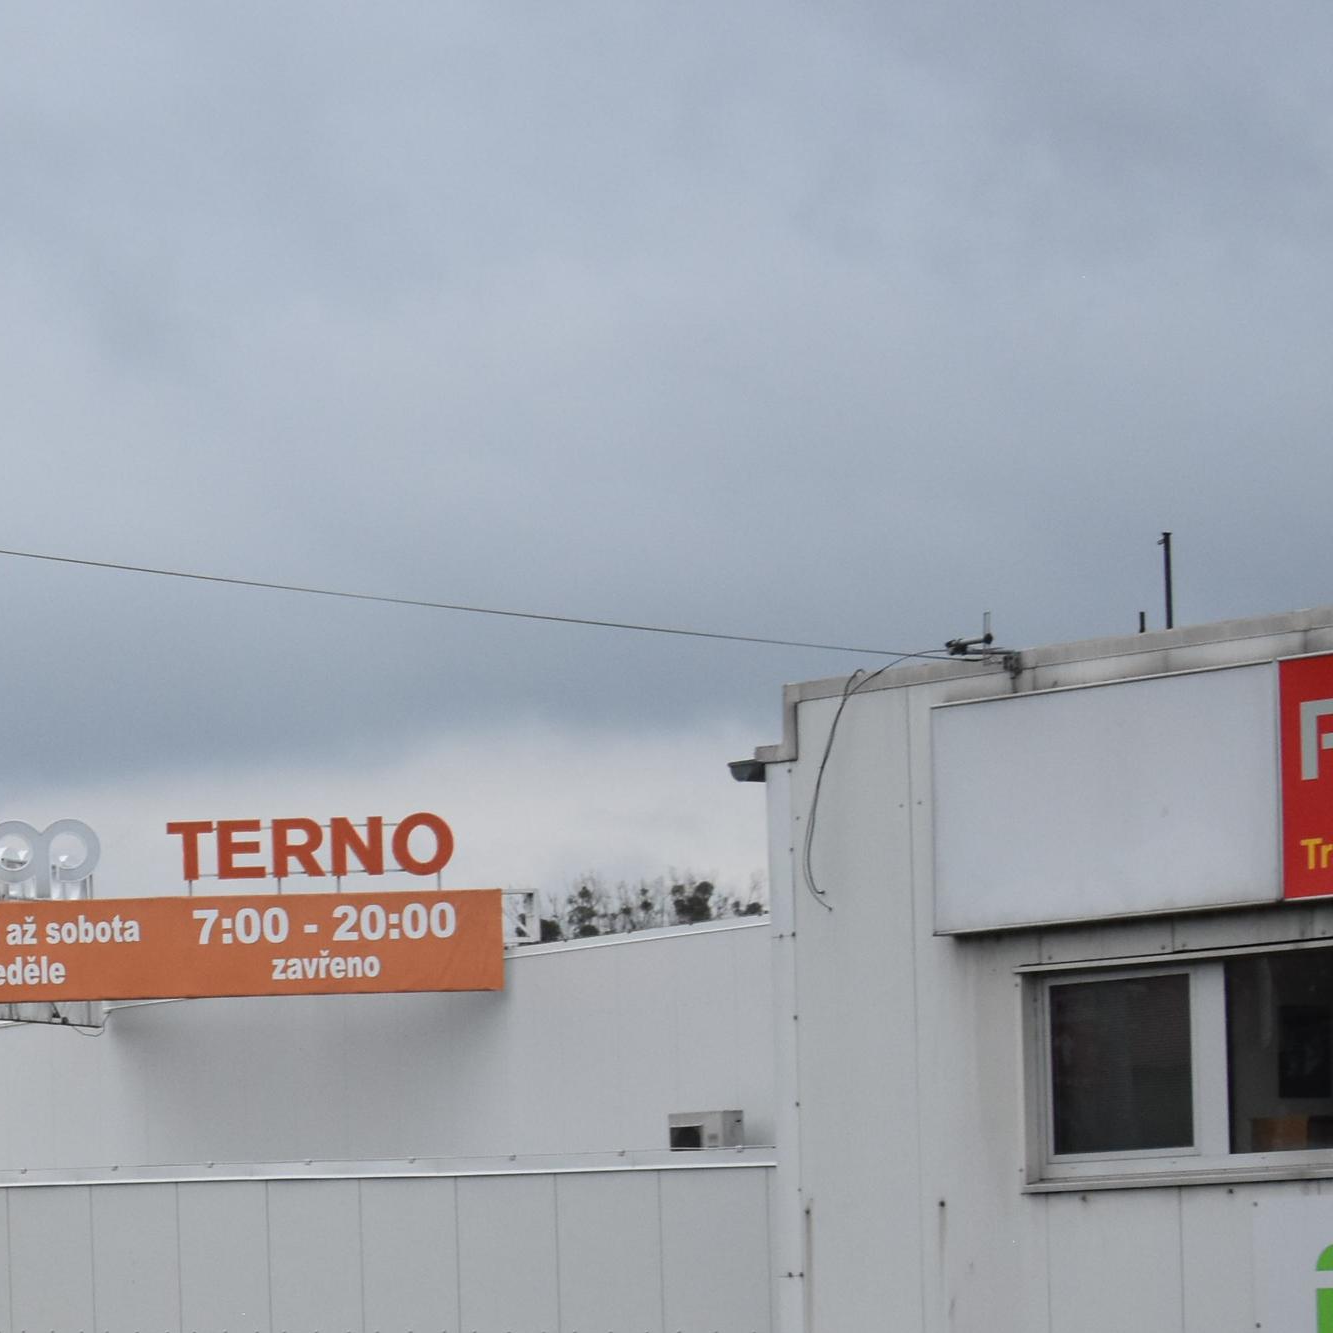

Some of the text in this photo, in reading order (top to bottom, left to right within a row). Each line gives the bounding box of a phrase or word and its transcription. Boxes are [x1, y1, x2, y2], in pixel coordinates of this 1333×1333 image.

[166, 812, 454, 881] TERNO
[6, 916, 38, 946] až
[45, 914, 141, 944] sobota
[192, 907, 289, 946] 7:00
[331, 902, 456, 942] 20:00
[271, 950, 381, 980] zavřeno
